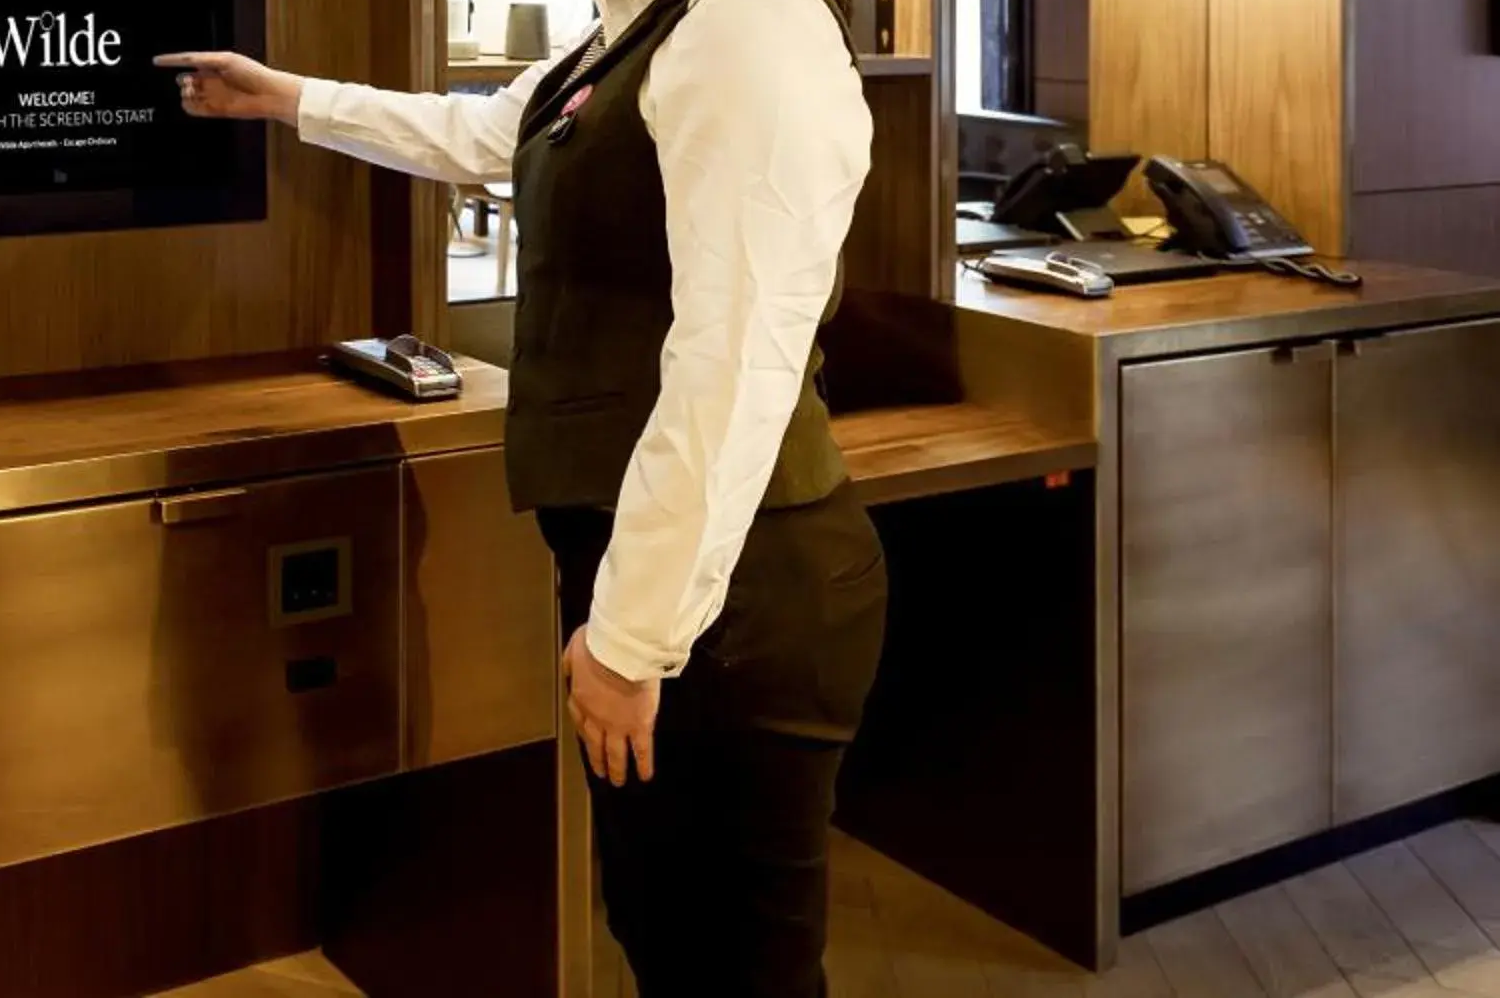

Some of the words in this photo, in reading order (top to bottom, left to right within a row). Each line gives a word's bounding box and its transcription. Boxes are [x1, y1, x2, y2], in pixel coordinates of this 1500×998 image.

[18, 90, 95, 107] WELCOME!
[9, 113, 36, 128] THE
[39, 111, 93, 127] SCREEN
[96, 110, 113, 126] TO
[115, 108, 154, 124] START
